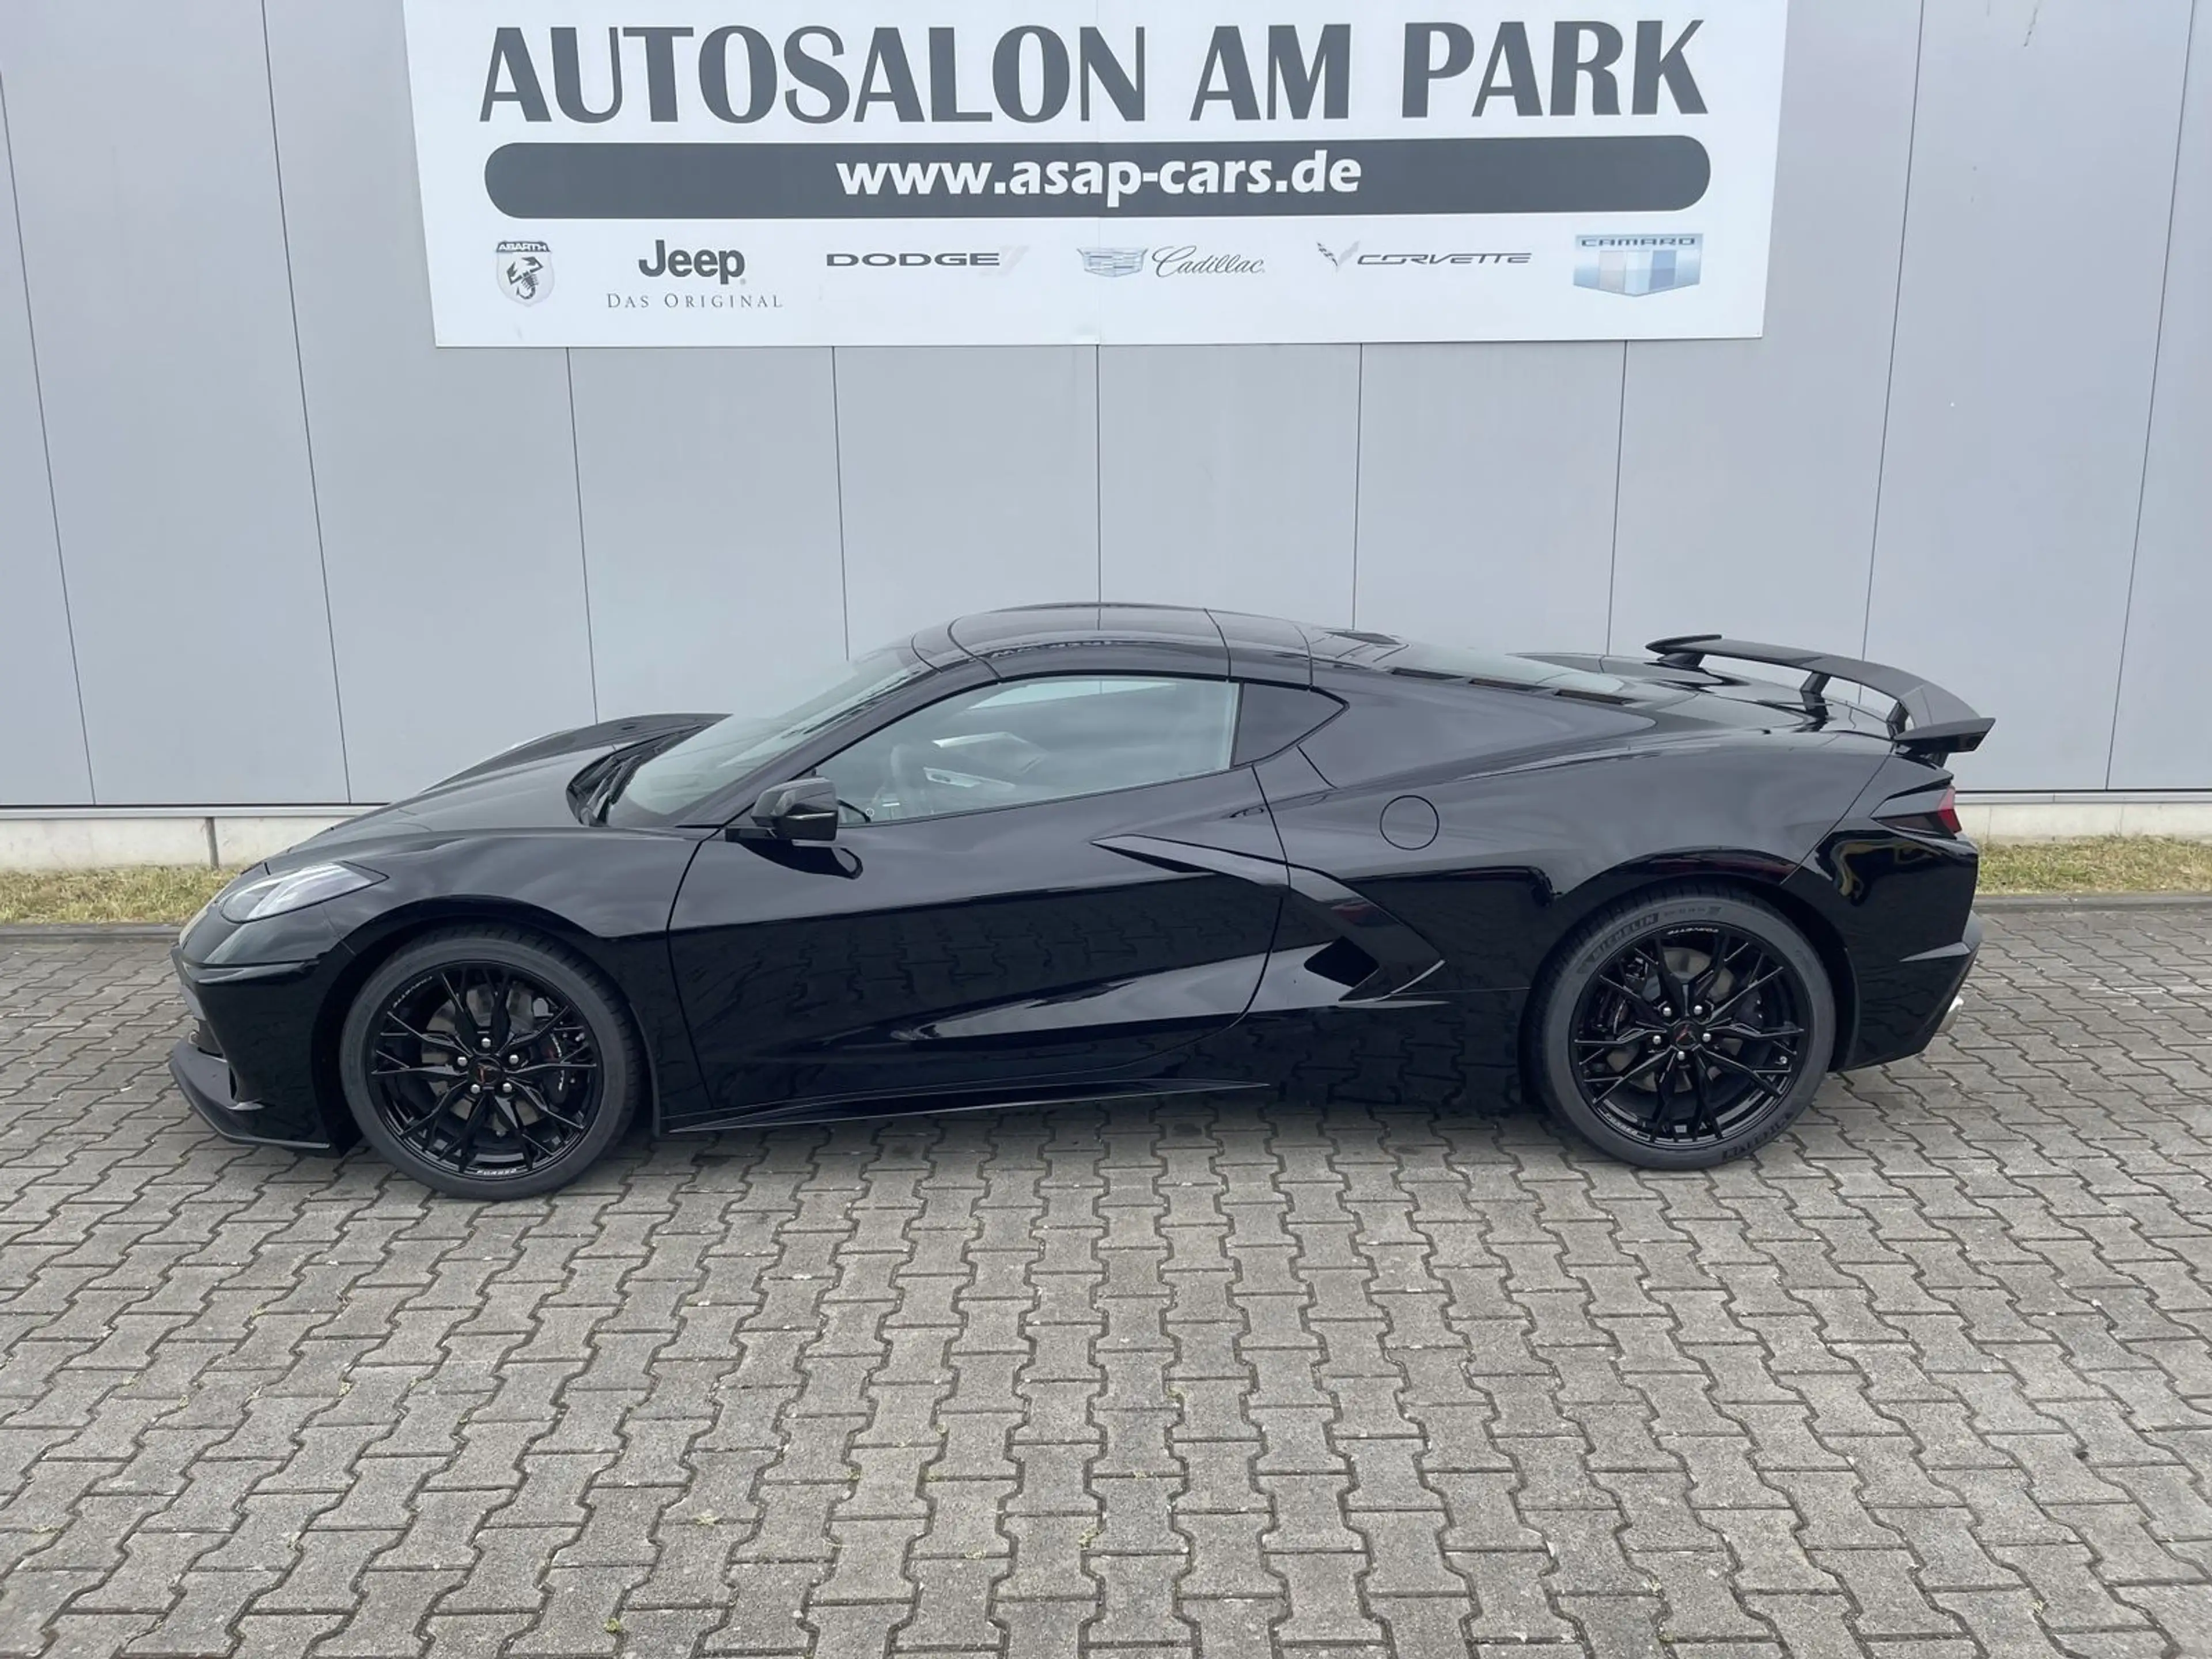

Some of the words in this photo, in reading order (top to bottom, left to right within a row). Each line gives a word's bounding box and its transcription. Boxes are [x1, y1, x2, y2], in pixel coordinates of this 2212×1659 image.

[479, 25, 1146, 124] AUTOSALON
[1189, 23, 1351, 122] AM
[1402, 19, 1709, 118] PARK
[835, 149, 1362, 209] www.asap-cars.de
[1581, 237, 1695, 247] CAMARO
[638, 239, 745, 285] Jeep
[826, 252, 1001, 267] DODGE
[1151, 245, 1263, 278] Cadillac
[1357, 252, 1533, 266] CORVETTE
